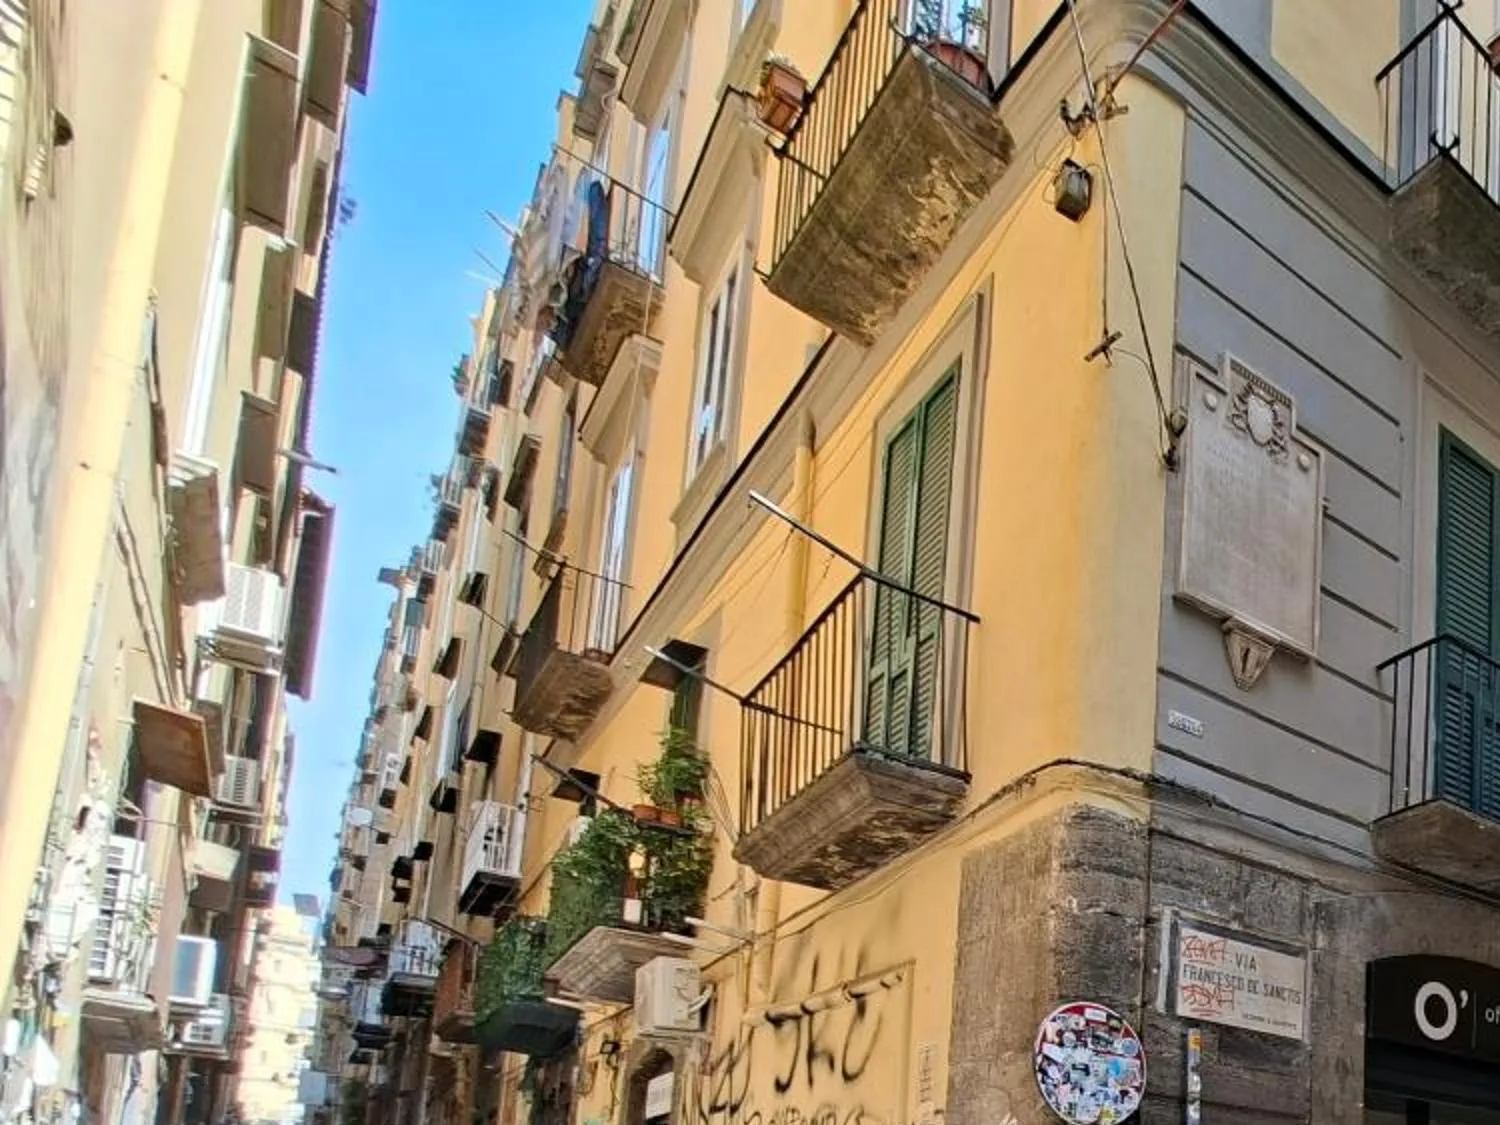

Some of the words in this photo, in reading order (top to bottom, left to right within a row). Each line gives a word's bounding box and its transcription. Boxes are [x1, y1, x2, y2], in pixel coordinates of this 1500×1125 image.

[1235, 951, 1257, 973] VIA
[1183, 963, 1245, 991] FRANCESCO
[1247, 978, 1260, 995] DE
